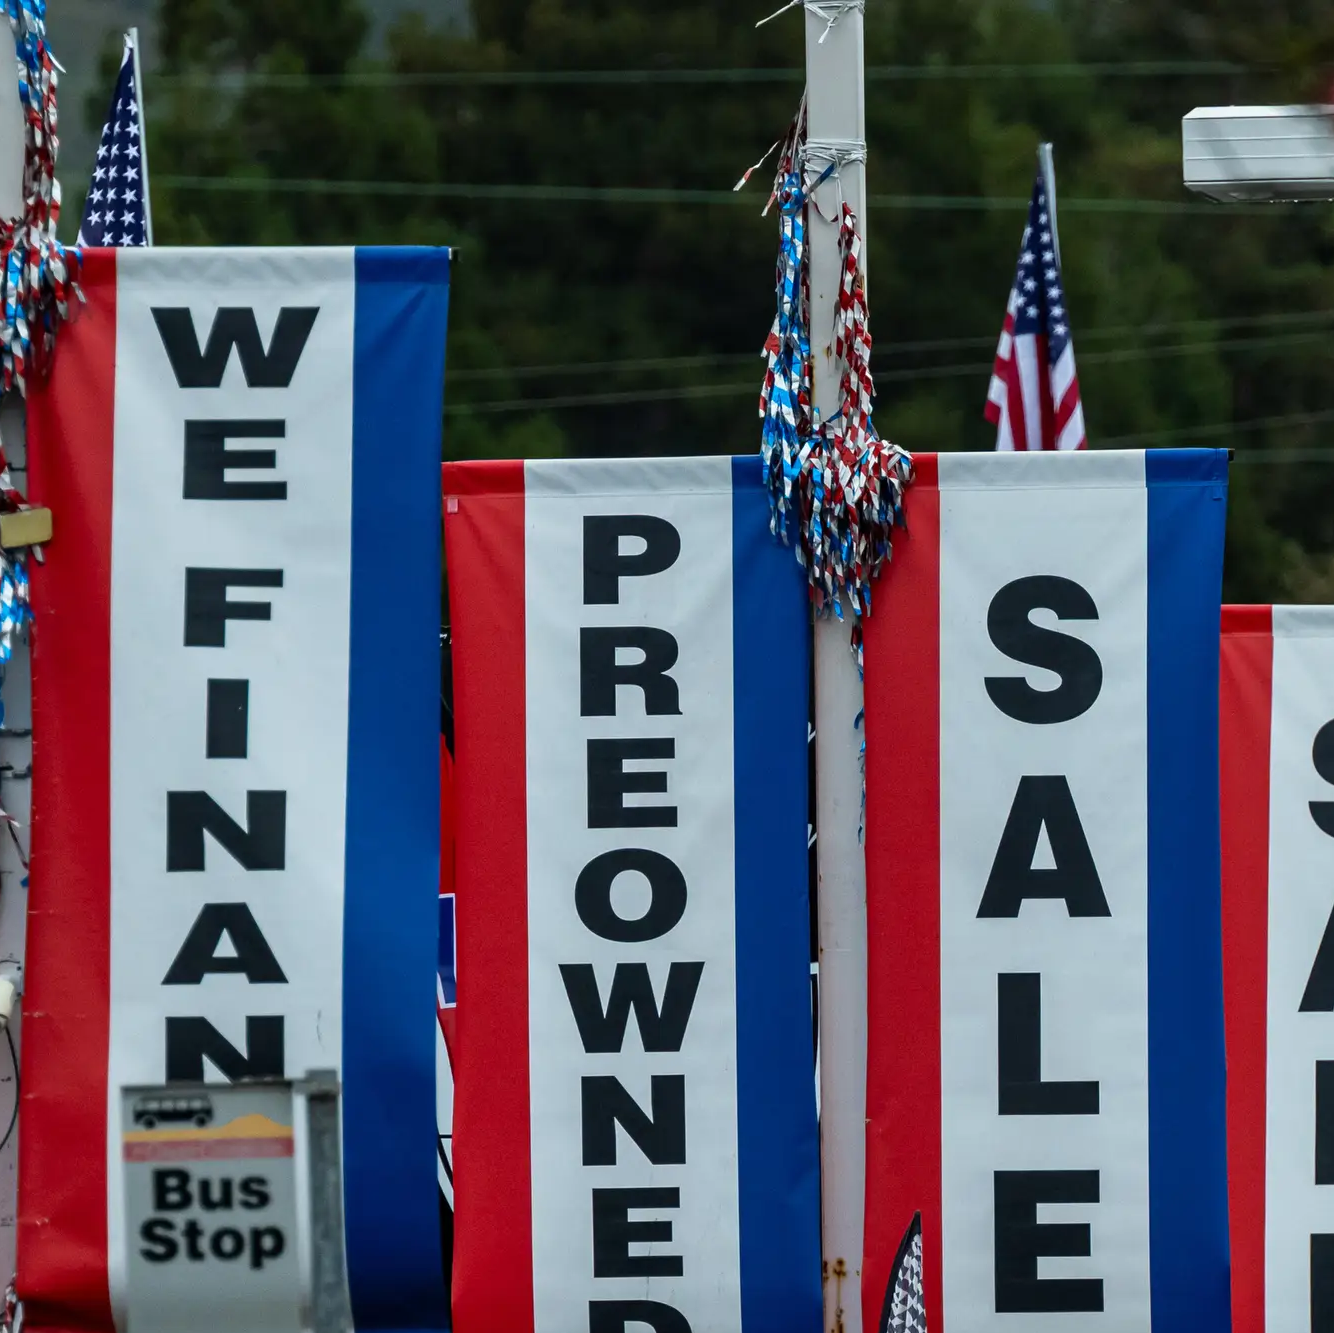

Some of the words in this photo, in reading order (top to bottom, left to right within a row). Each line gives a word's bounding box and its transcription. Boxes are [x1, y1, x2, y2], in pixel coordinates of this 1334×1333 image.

[151, 306, 320, 500] WE
[161, 567, 290, 1083] FINAN
[976, 574, 1113, 1313] SALE
[139, 1217, 286, 1270] Stop
[152, 1167, 271, 1212] Bus
